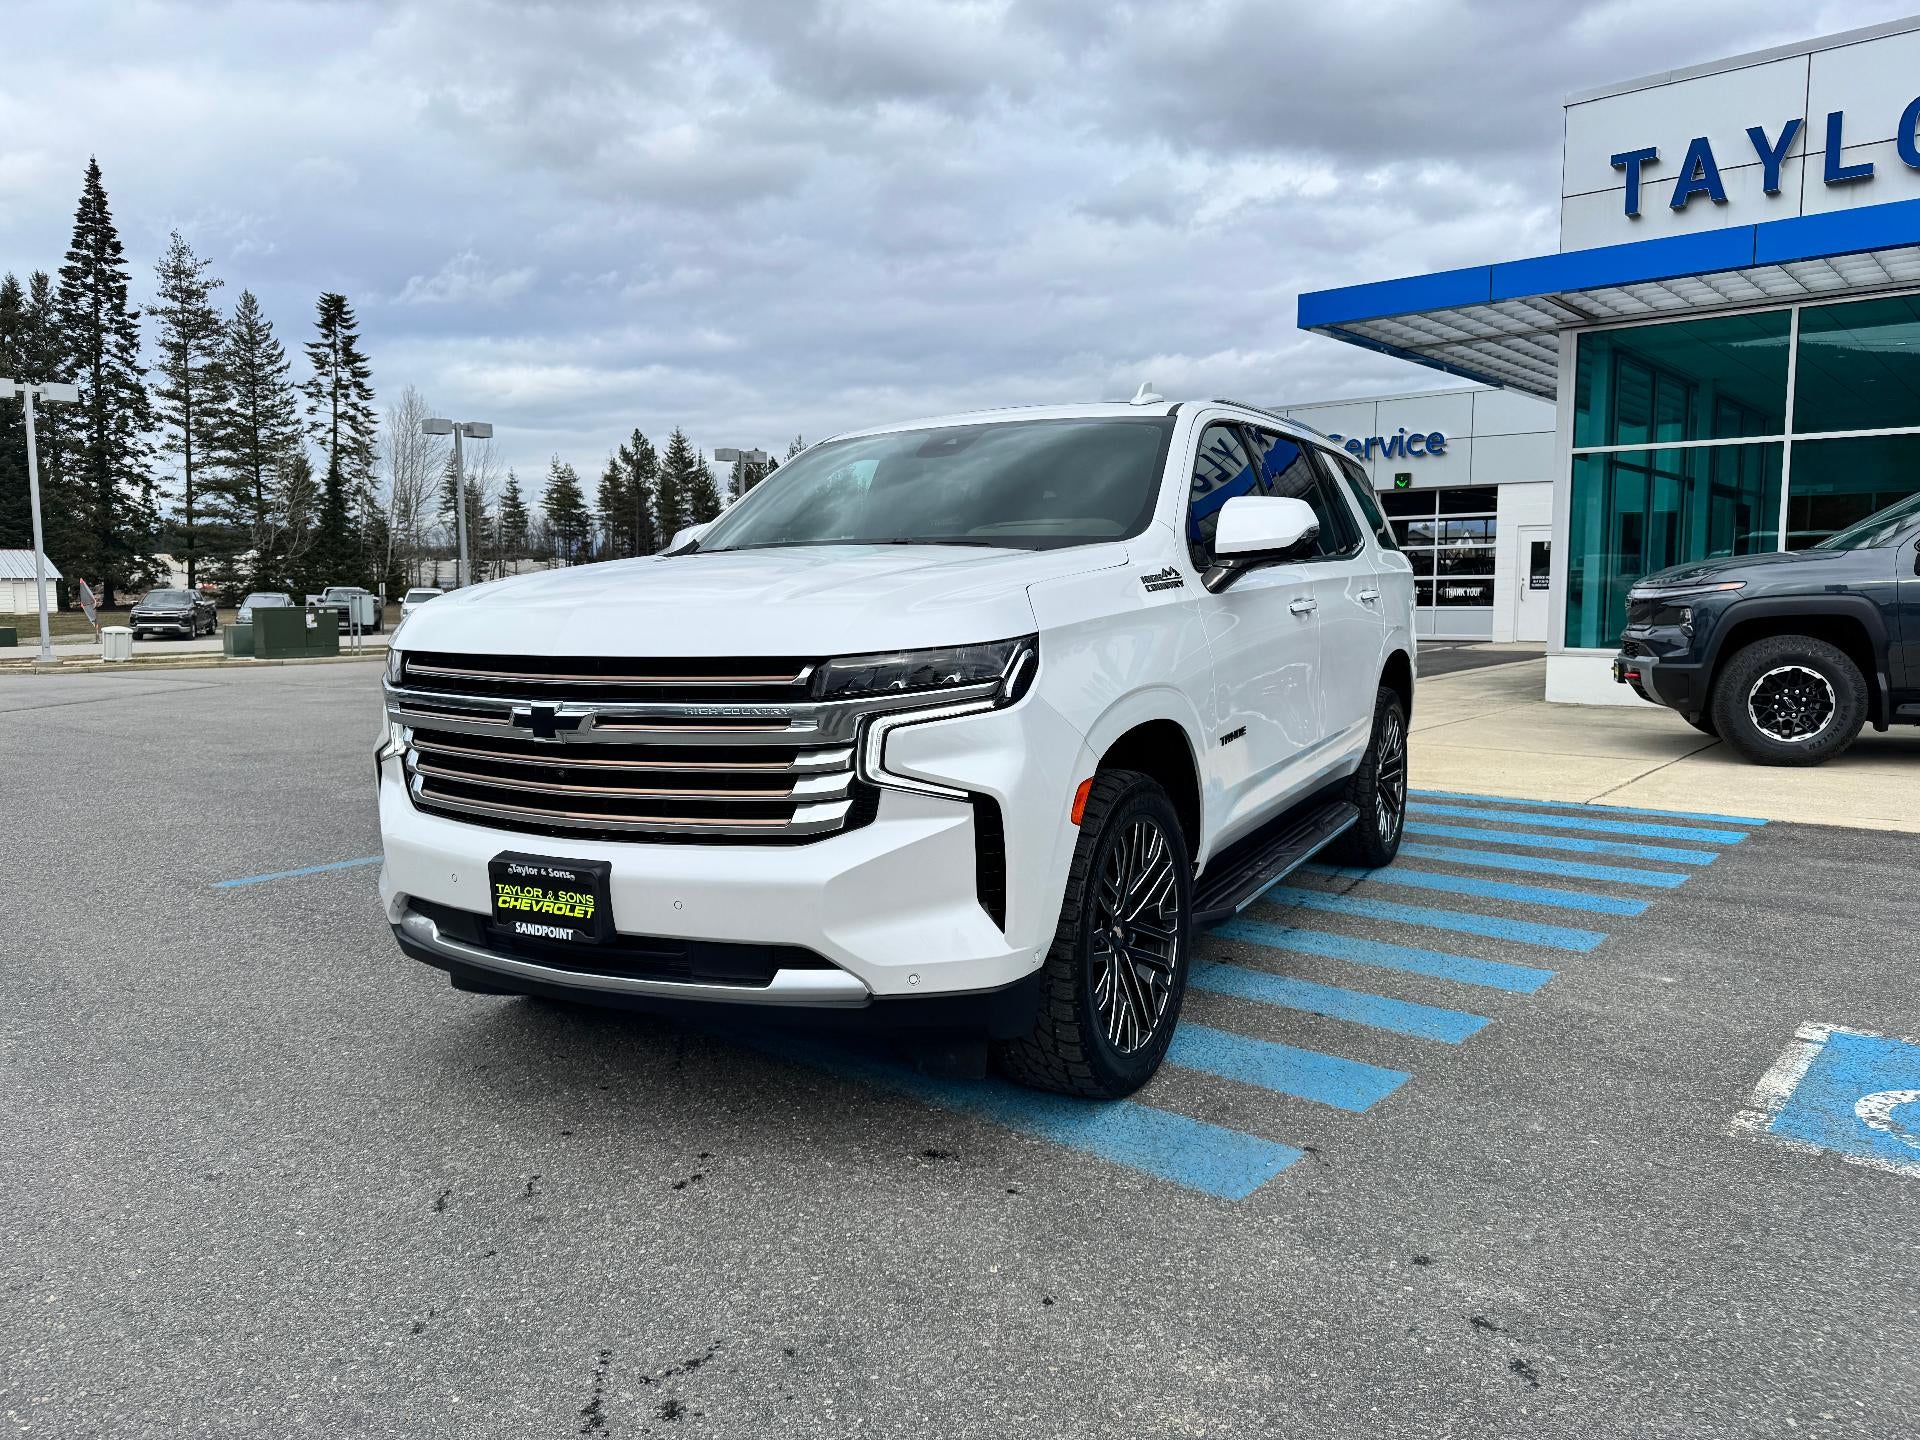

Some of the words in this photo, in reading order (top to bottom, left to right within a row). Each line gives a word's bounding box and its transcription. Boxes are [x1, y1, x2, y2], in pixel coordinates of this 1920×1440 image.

[1328, 428, 1446, 460] ervice
[722, 707, 791, 715] COUNTRY
[1219, 725, 1247, 746] TAHOE
[510, 863, 538, 877] Taylor
[540, 868, 547, 876] &
[548, 868, 571, 879] Sons
[495, 884, 543, 898] TAYLOR
[546, 890, 555, 901] &
[558, 890, 595, 905] SONS
[497, 896, 595, 919] CHEVROLET
[515, 921, 574, 940] SANDPOINT
